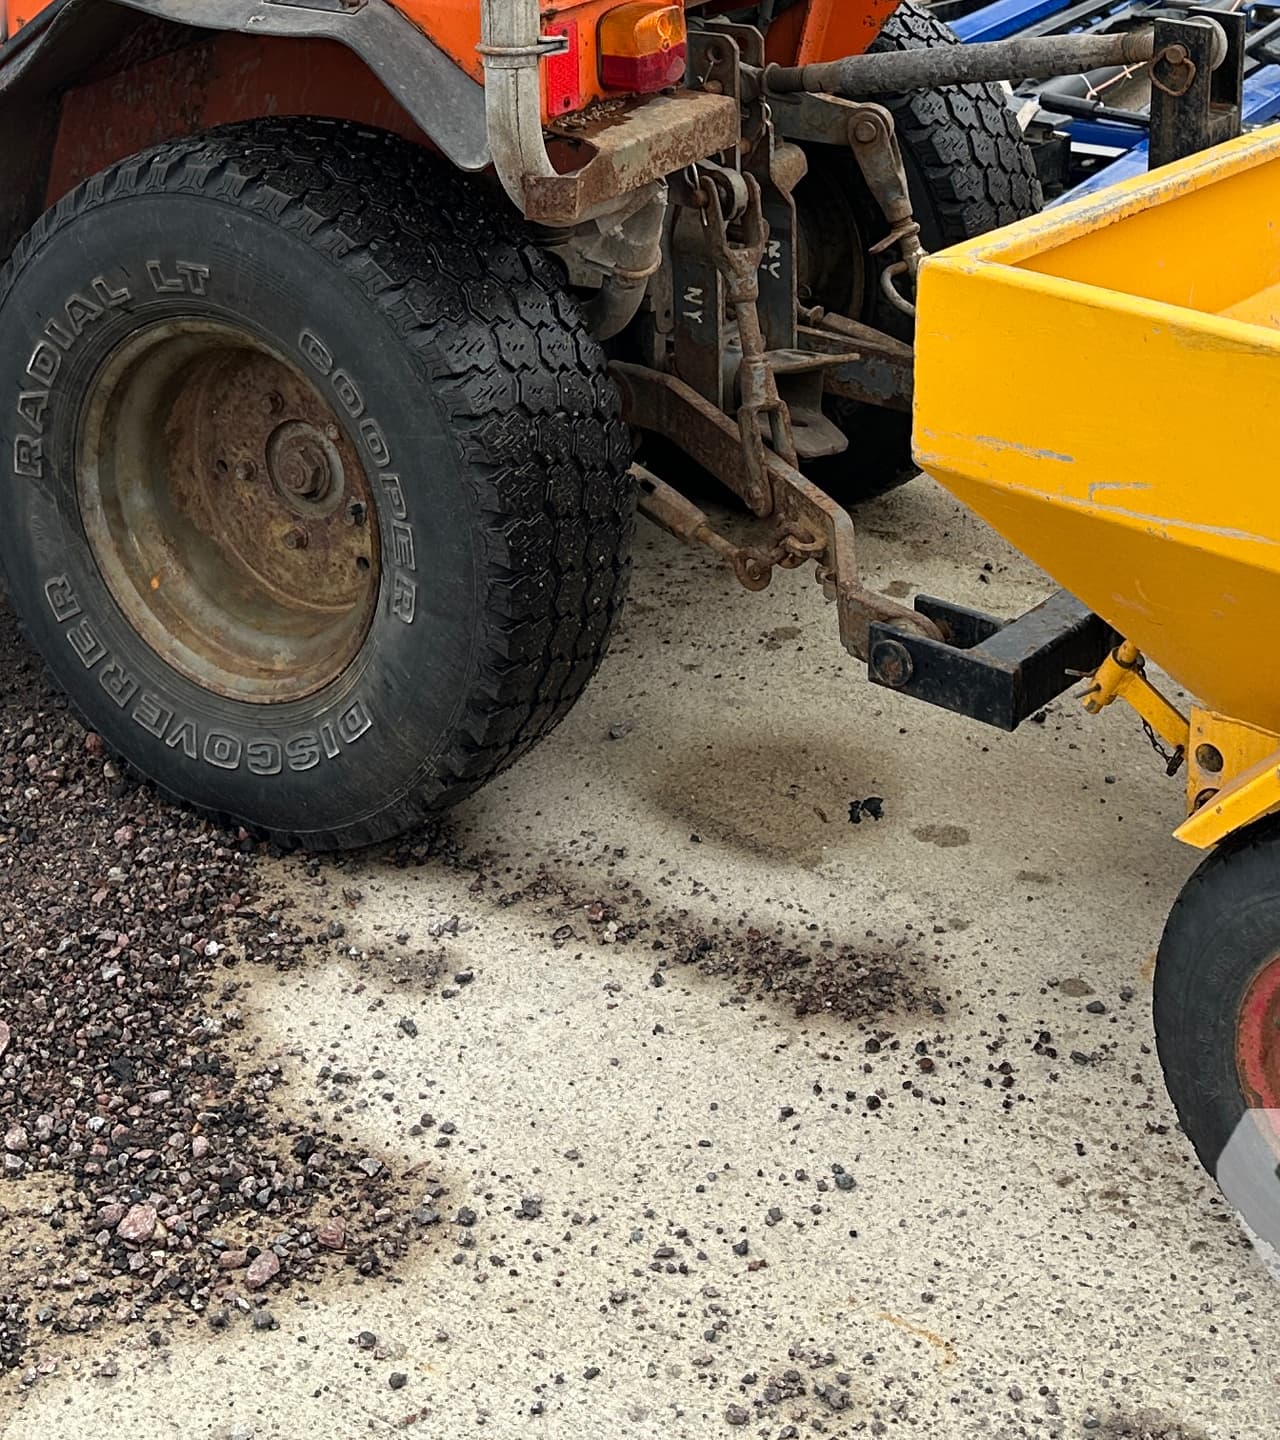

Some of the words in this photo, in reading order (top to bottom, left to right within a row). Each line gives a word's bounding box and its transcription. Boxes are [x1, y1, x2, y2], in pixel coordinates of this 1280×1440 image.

[14, 275, 131, 478] RADIAL
[144, 260, 211, 295] LT
[297, 327, 418, 625] COOPER
[43, 575, 374, 776] DISCOVERER
